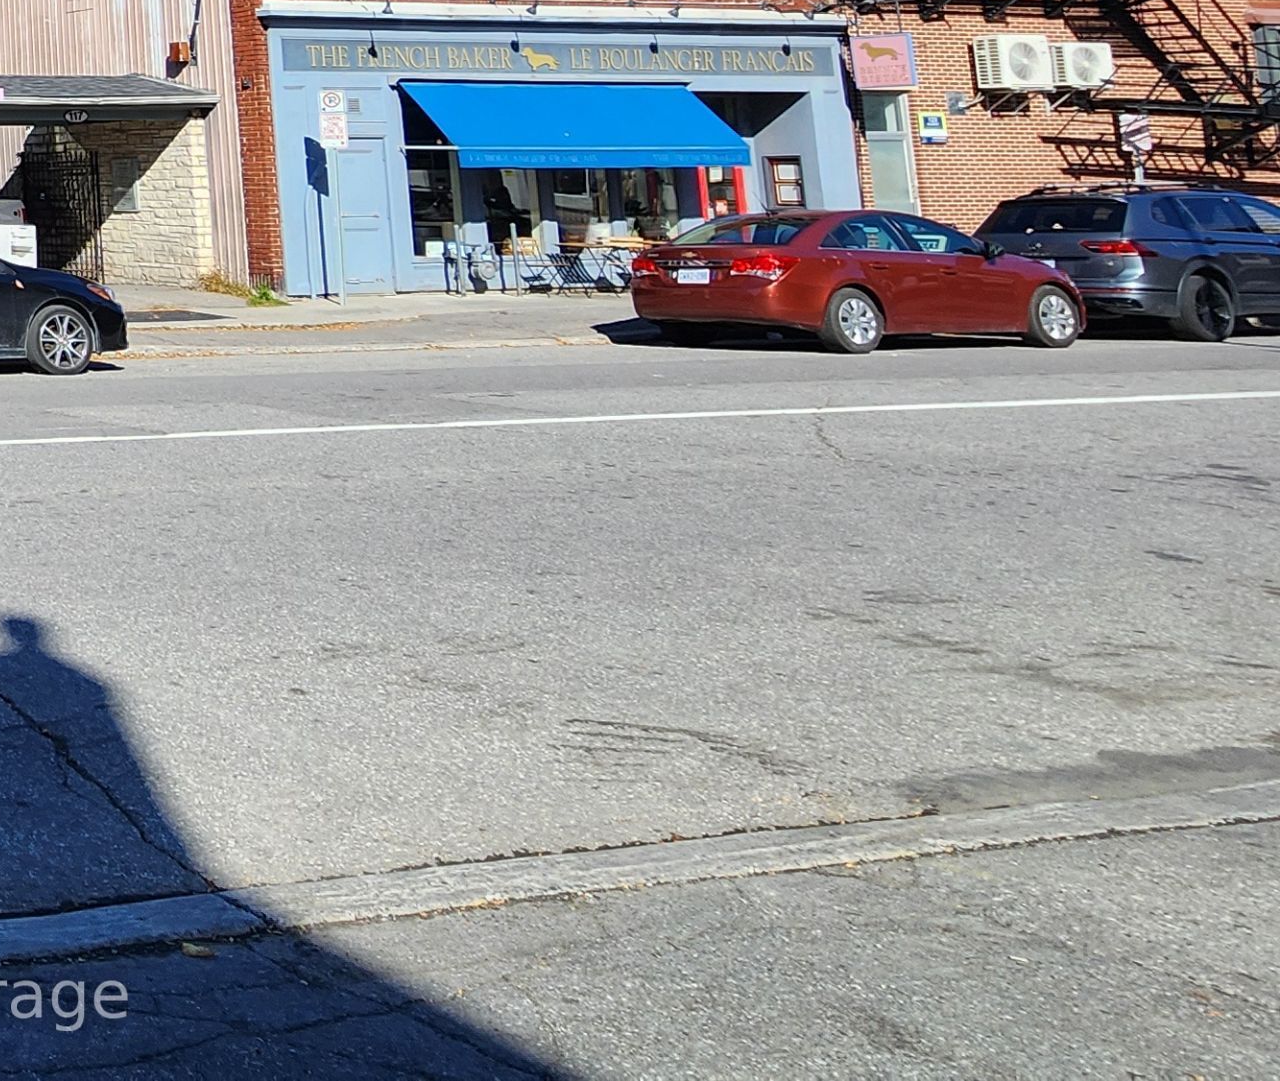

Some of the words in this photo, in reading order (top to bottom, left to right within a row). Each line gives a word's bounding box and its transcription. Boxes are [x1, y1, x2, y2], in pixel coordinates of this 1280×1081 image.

[306, 44, 351, 67] THE
[356, 45, 440, 69] FRENCH
[447, 46, 512, 69] BAKER
[569, 48, 592, 69] LE
[598, 47, 715, 71] BOULANGER
[69, 110, 84, 121] 117
